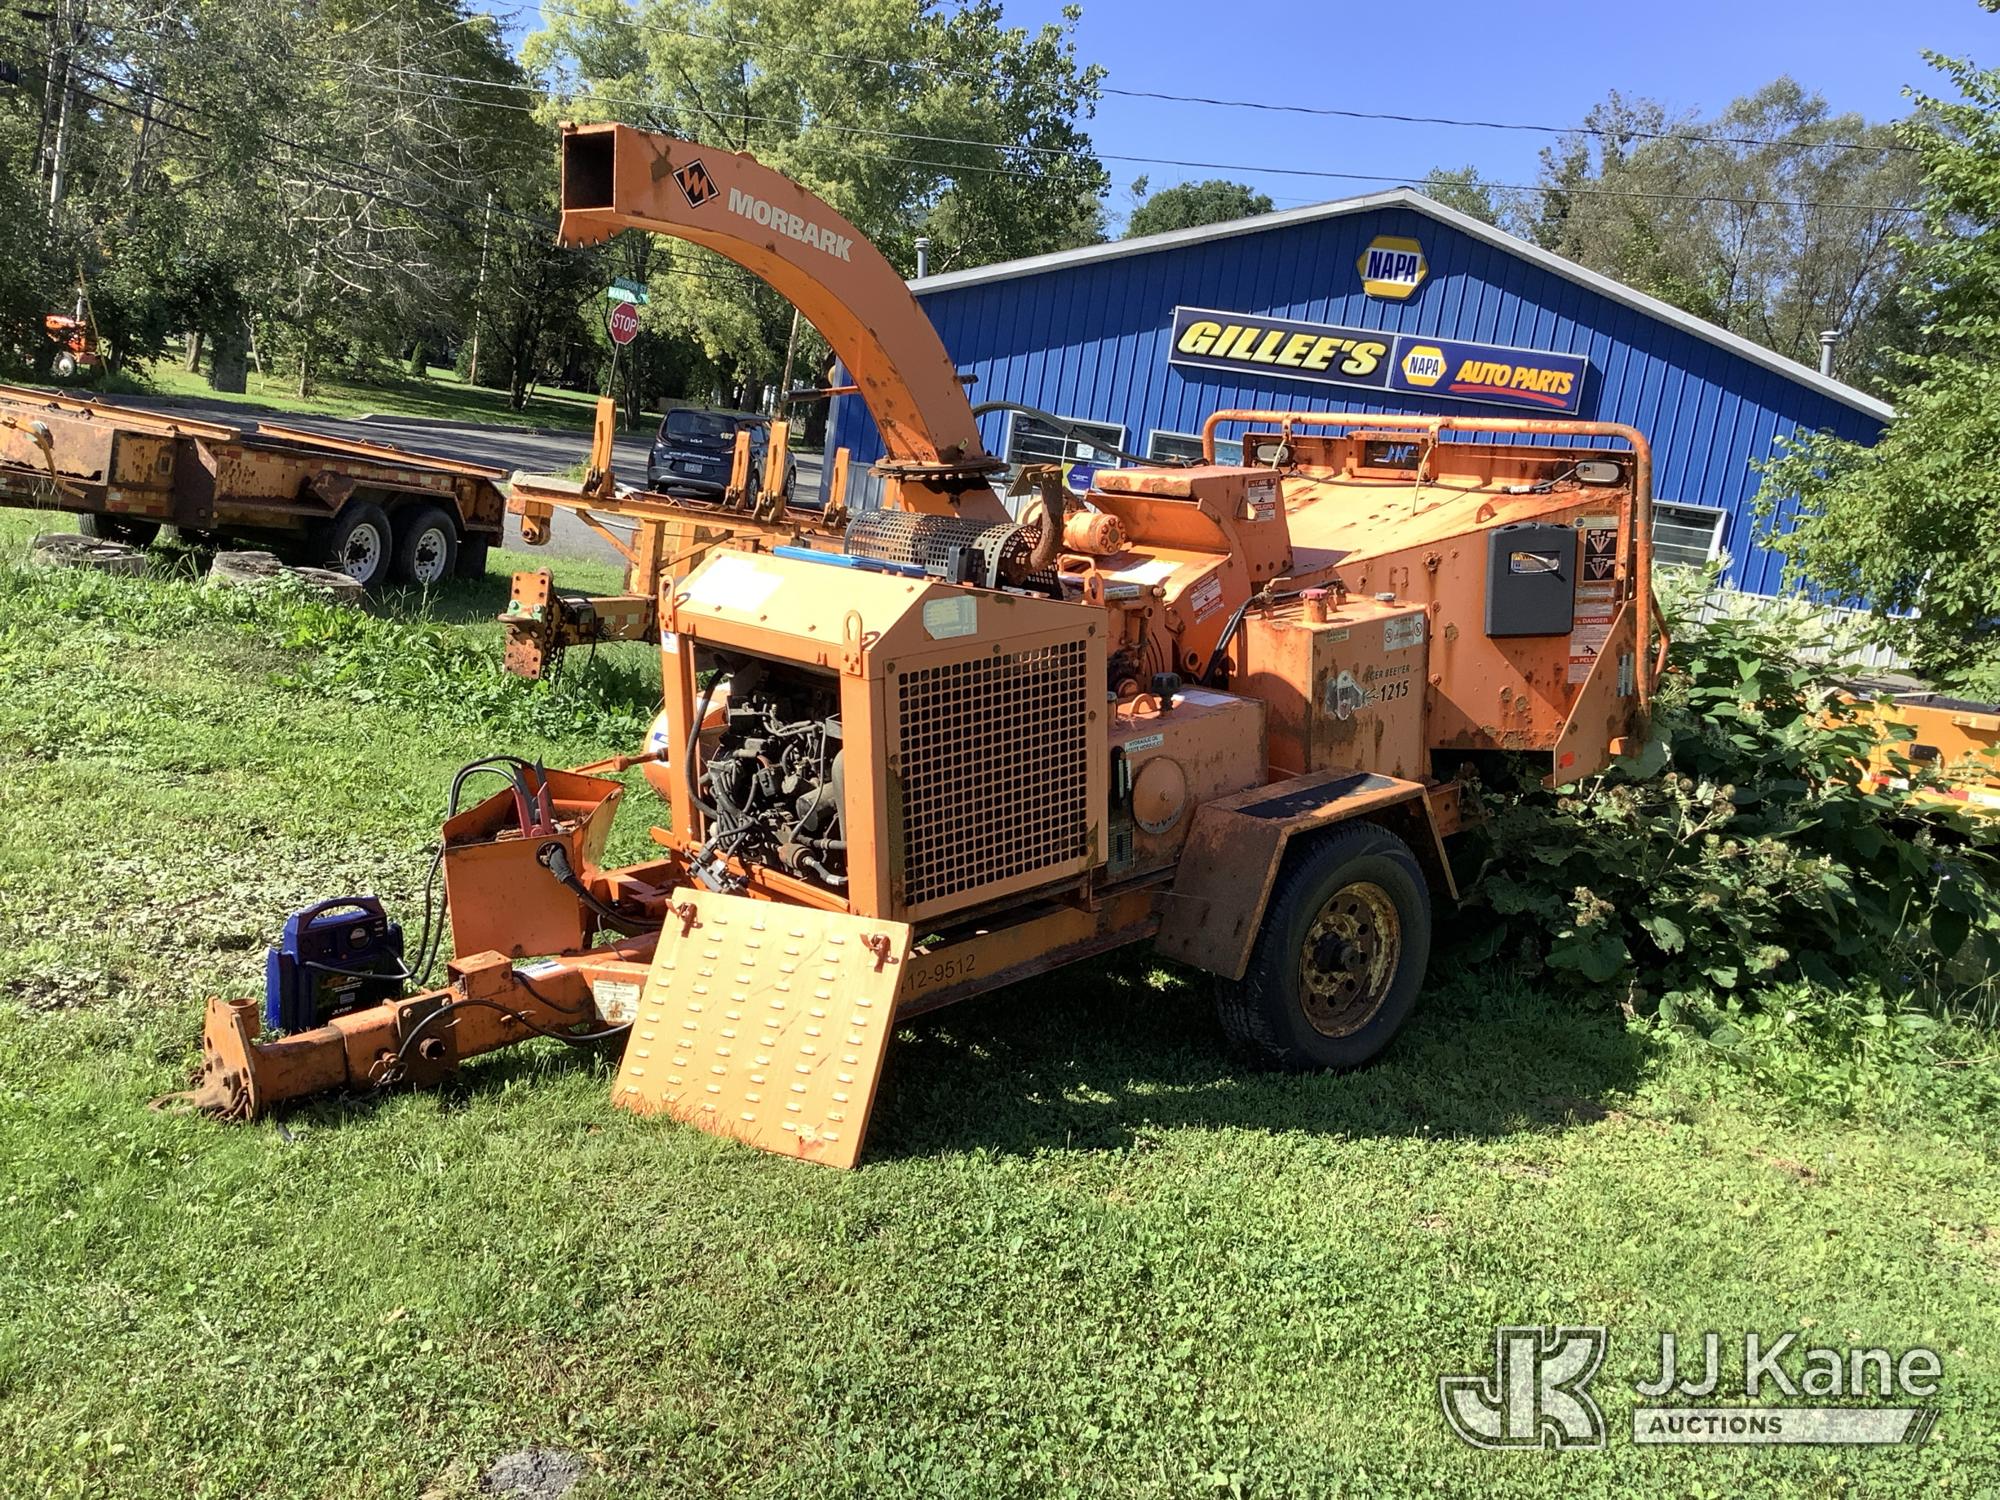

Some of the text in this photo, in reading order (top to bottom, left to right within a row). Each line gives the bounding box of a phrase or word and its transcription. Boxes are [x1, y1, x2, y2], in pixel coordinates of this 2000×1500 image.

[728, 187, 853, 262] MORBARK
[1367, 251, 1418, 283] NAPA
[613, 313, 637, 333] STOP
[1178, 321, 1386, 376] GILLEE'S
[1409, 356, 1439, 376] NAPA
[1455, 360, 1575, 395] AUTO PARTS
[1381, 680, 1409, 702] 1215
